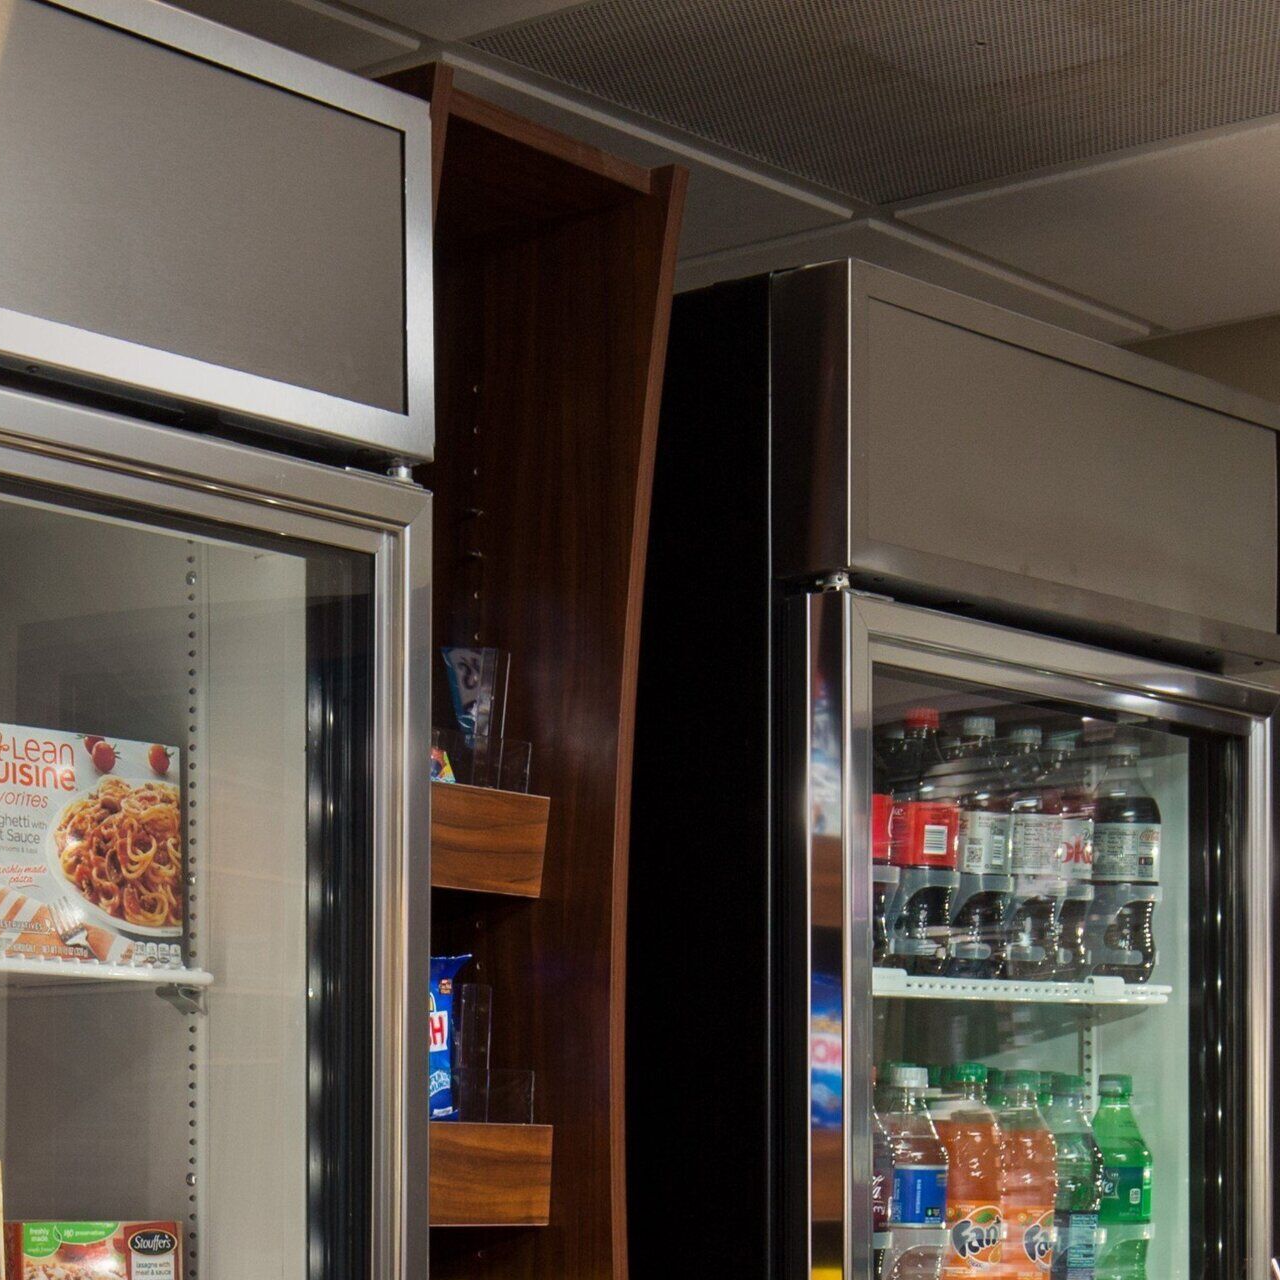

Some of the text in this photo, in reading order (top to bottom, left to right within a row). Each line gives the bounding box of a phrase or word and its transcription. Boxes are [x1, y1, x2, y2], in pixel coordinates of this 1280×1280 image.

[12, 737, 75, 767] Lean
[32, 820, 47, 830] with
[7, 829, 40, 844] Sauce
[134, 1234, 172, 1252] Stouffer's
